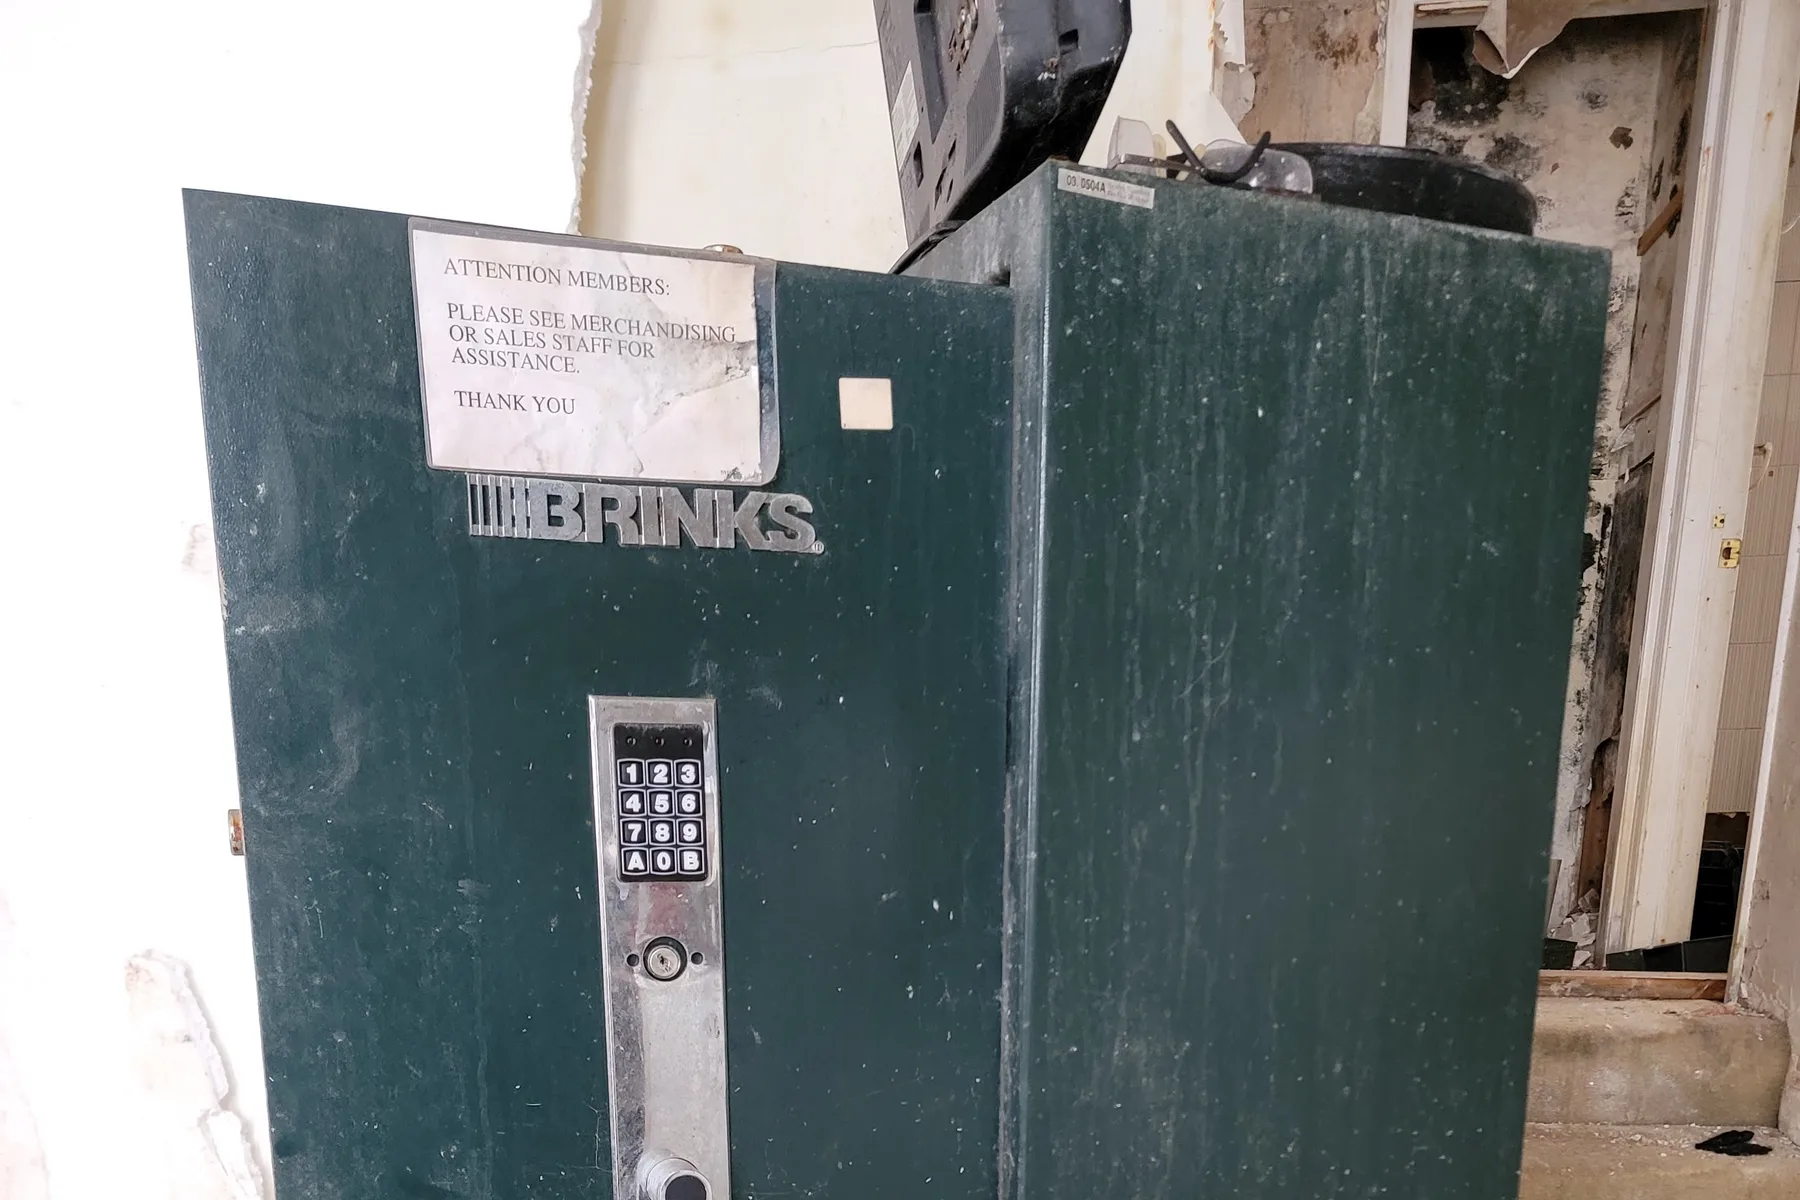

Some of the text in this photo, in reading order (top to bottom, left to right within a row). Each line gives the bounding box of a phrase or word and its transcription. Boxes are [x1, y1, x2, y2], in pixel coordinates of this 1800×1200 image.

[444, 257, 670, 296] ATTENTION MEMBERS:
[447, 302, 736, 343] PLEASE SEE MERCHANDISING
[449, 323, 656, 359] OR SALES STAFF FOR
[451, 347, 581, 374] ASSISTANCE.
[453, 389, 575, 415] THANK YOU
[626, 763, 696, 784] 1 2 3
[625, 793, 696, 813] 4 5 6
[627, 823, 697, 842] 7 8 9
[627, 851, 645, 871] A
[683, 851, 699, 871] B
